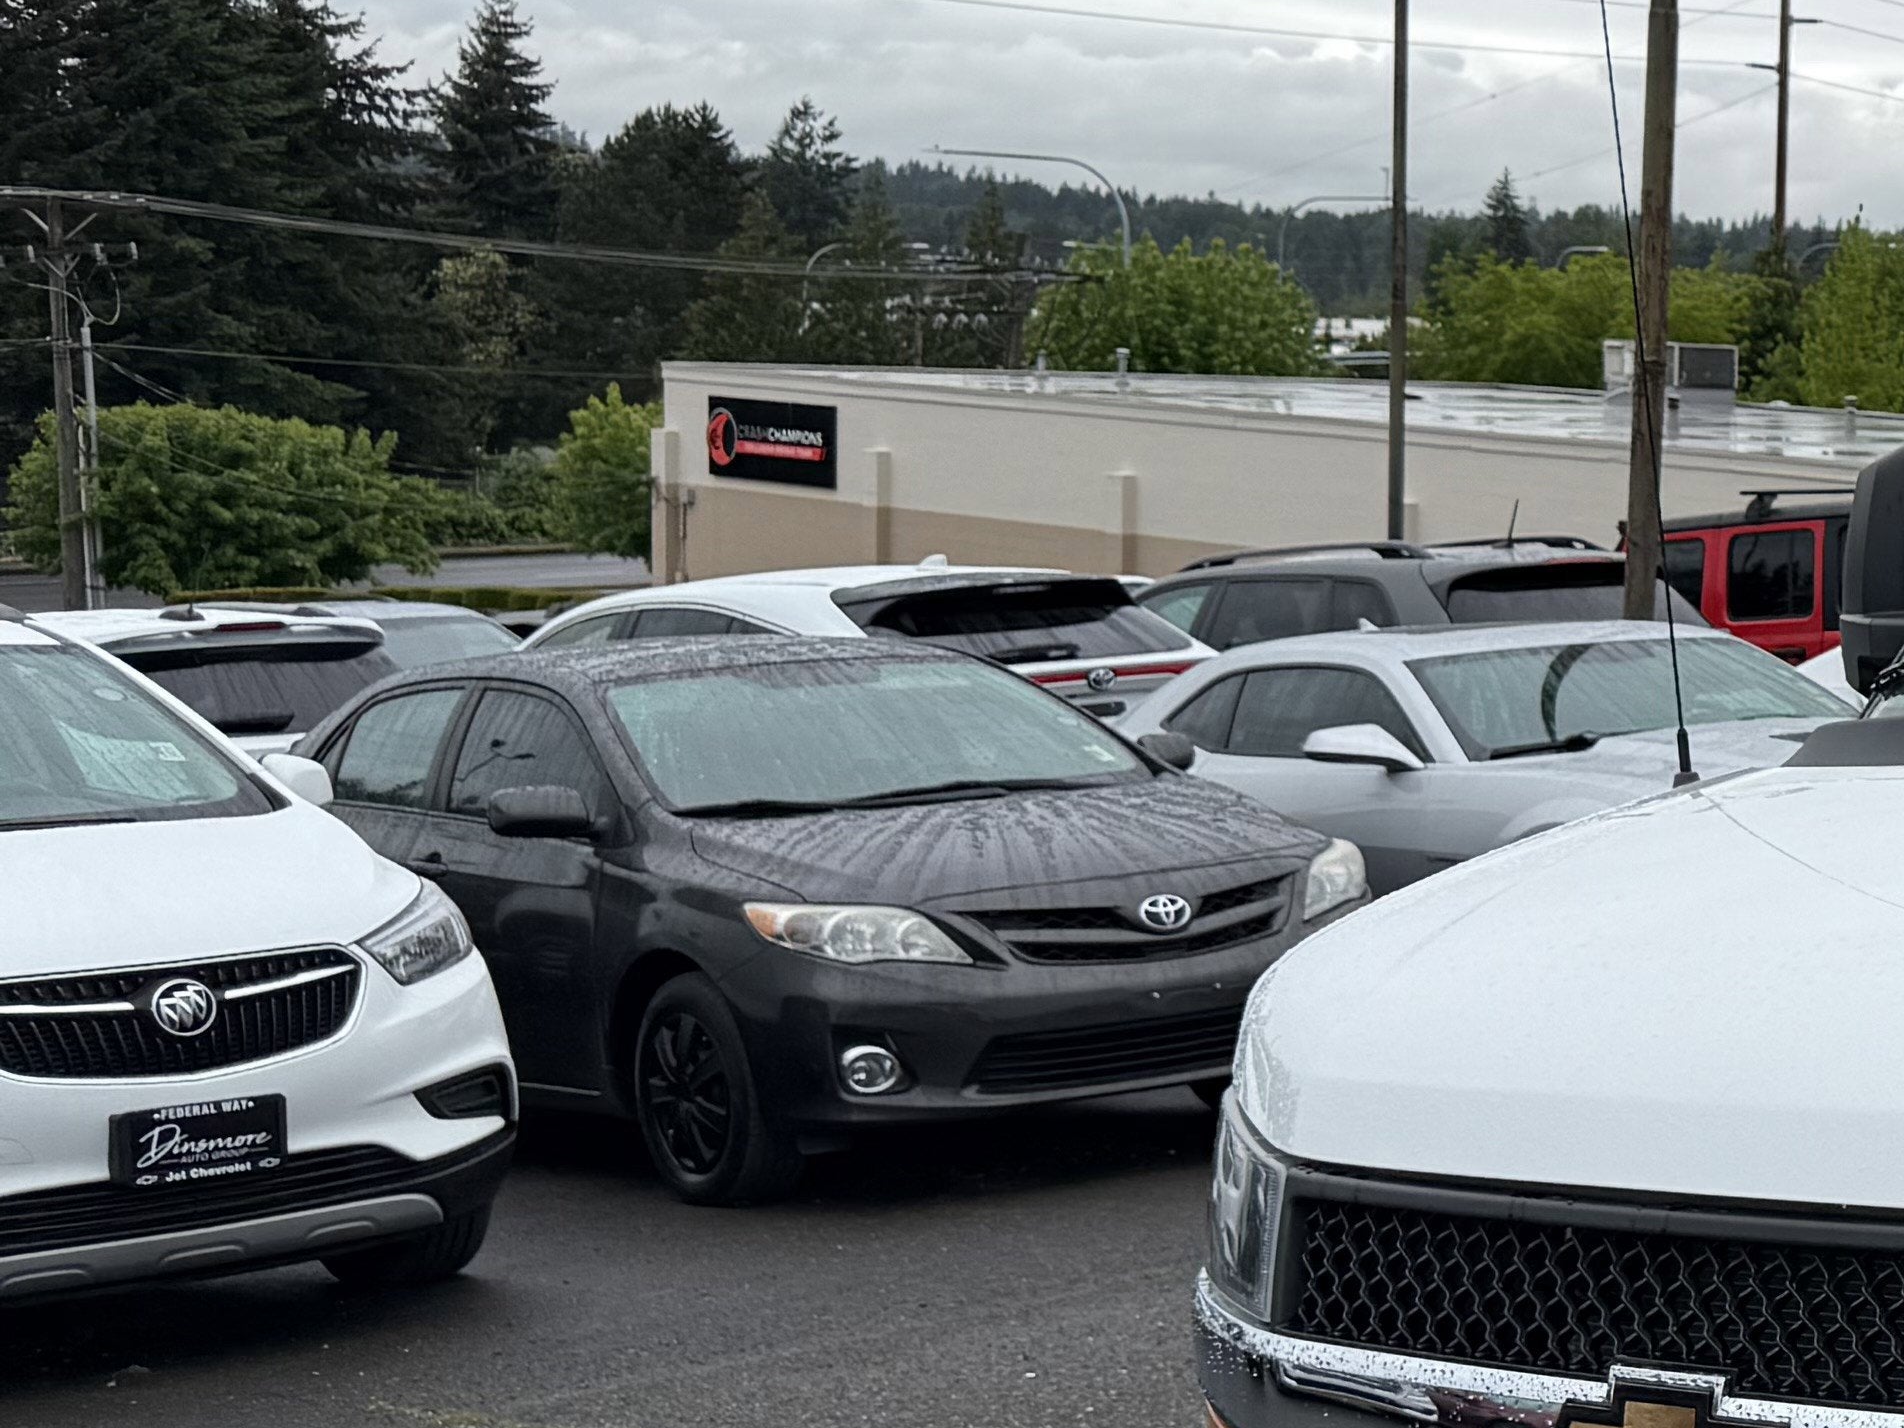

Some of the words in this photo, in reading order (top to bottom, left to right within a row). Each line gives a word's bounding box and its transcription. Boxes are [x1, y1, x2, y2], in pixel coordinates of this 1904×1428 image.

[160, 1102, 218, 1121] FEDERAL
[221, 1099, 248, 1113] WAY
[136, 1124, 273, 1169] Dinsmore
[179, 1152, 210, 1164] AUTO
[165, 1171, 187, 1183] Jet
[190, 1160, 252, 1179] Chevrolet
